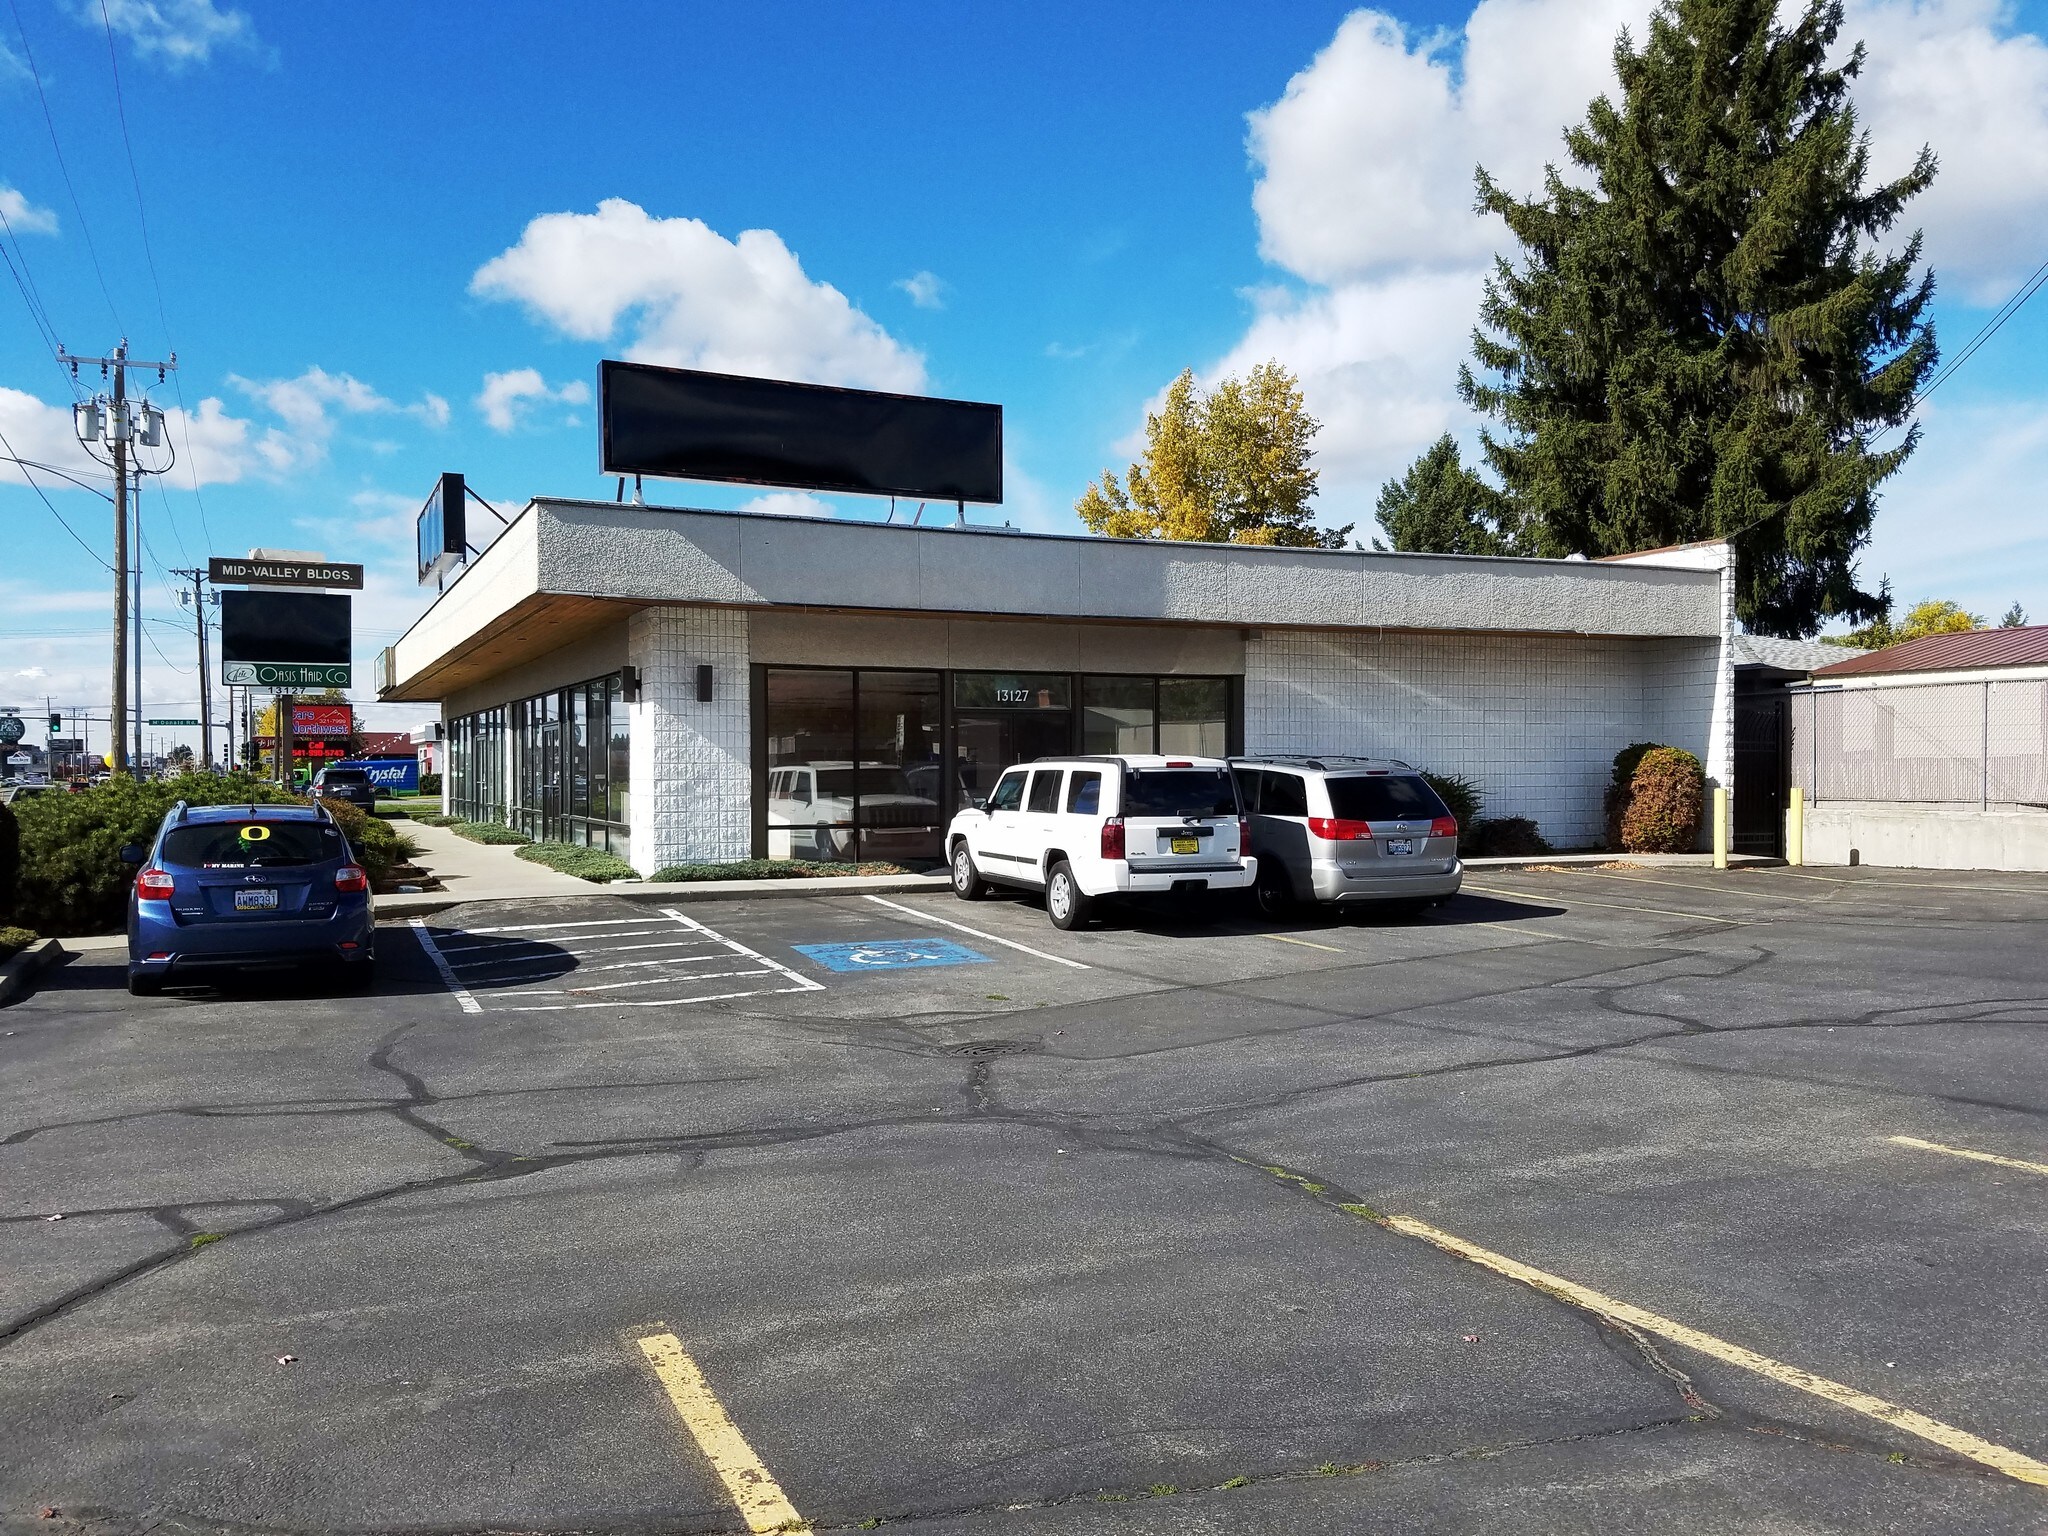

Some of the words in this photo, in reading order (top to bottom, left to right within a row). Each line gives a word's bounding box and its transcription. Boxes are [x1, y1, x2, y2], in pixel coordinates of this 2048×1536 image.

[222, 565, 301, 578] MID-VALLEY
[306, 568, 353, 581] BLDGS.
[260, 666, 297, 682] OASIS
[299, 667, 323, 683] HAIR
[325, 668, 348, 684] CO.
[267, 686, 306, 694] 13127
[997, 689, 1029, 702] 13127
[308, 741, 324, 749] Call
